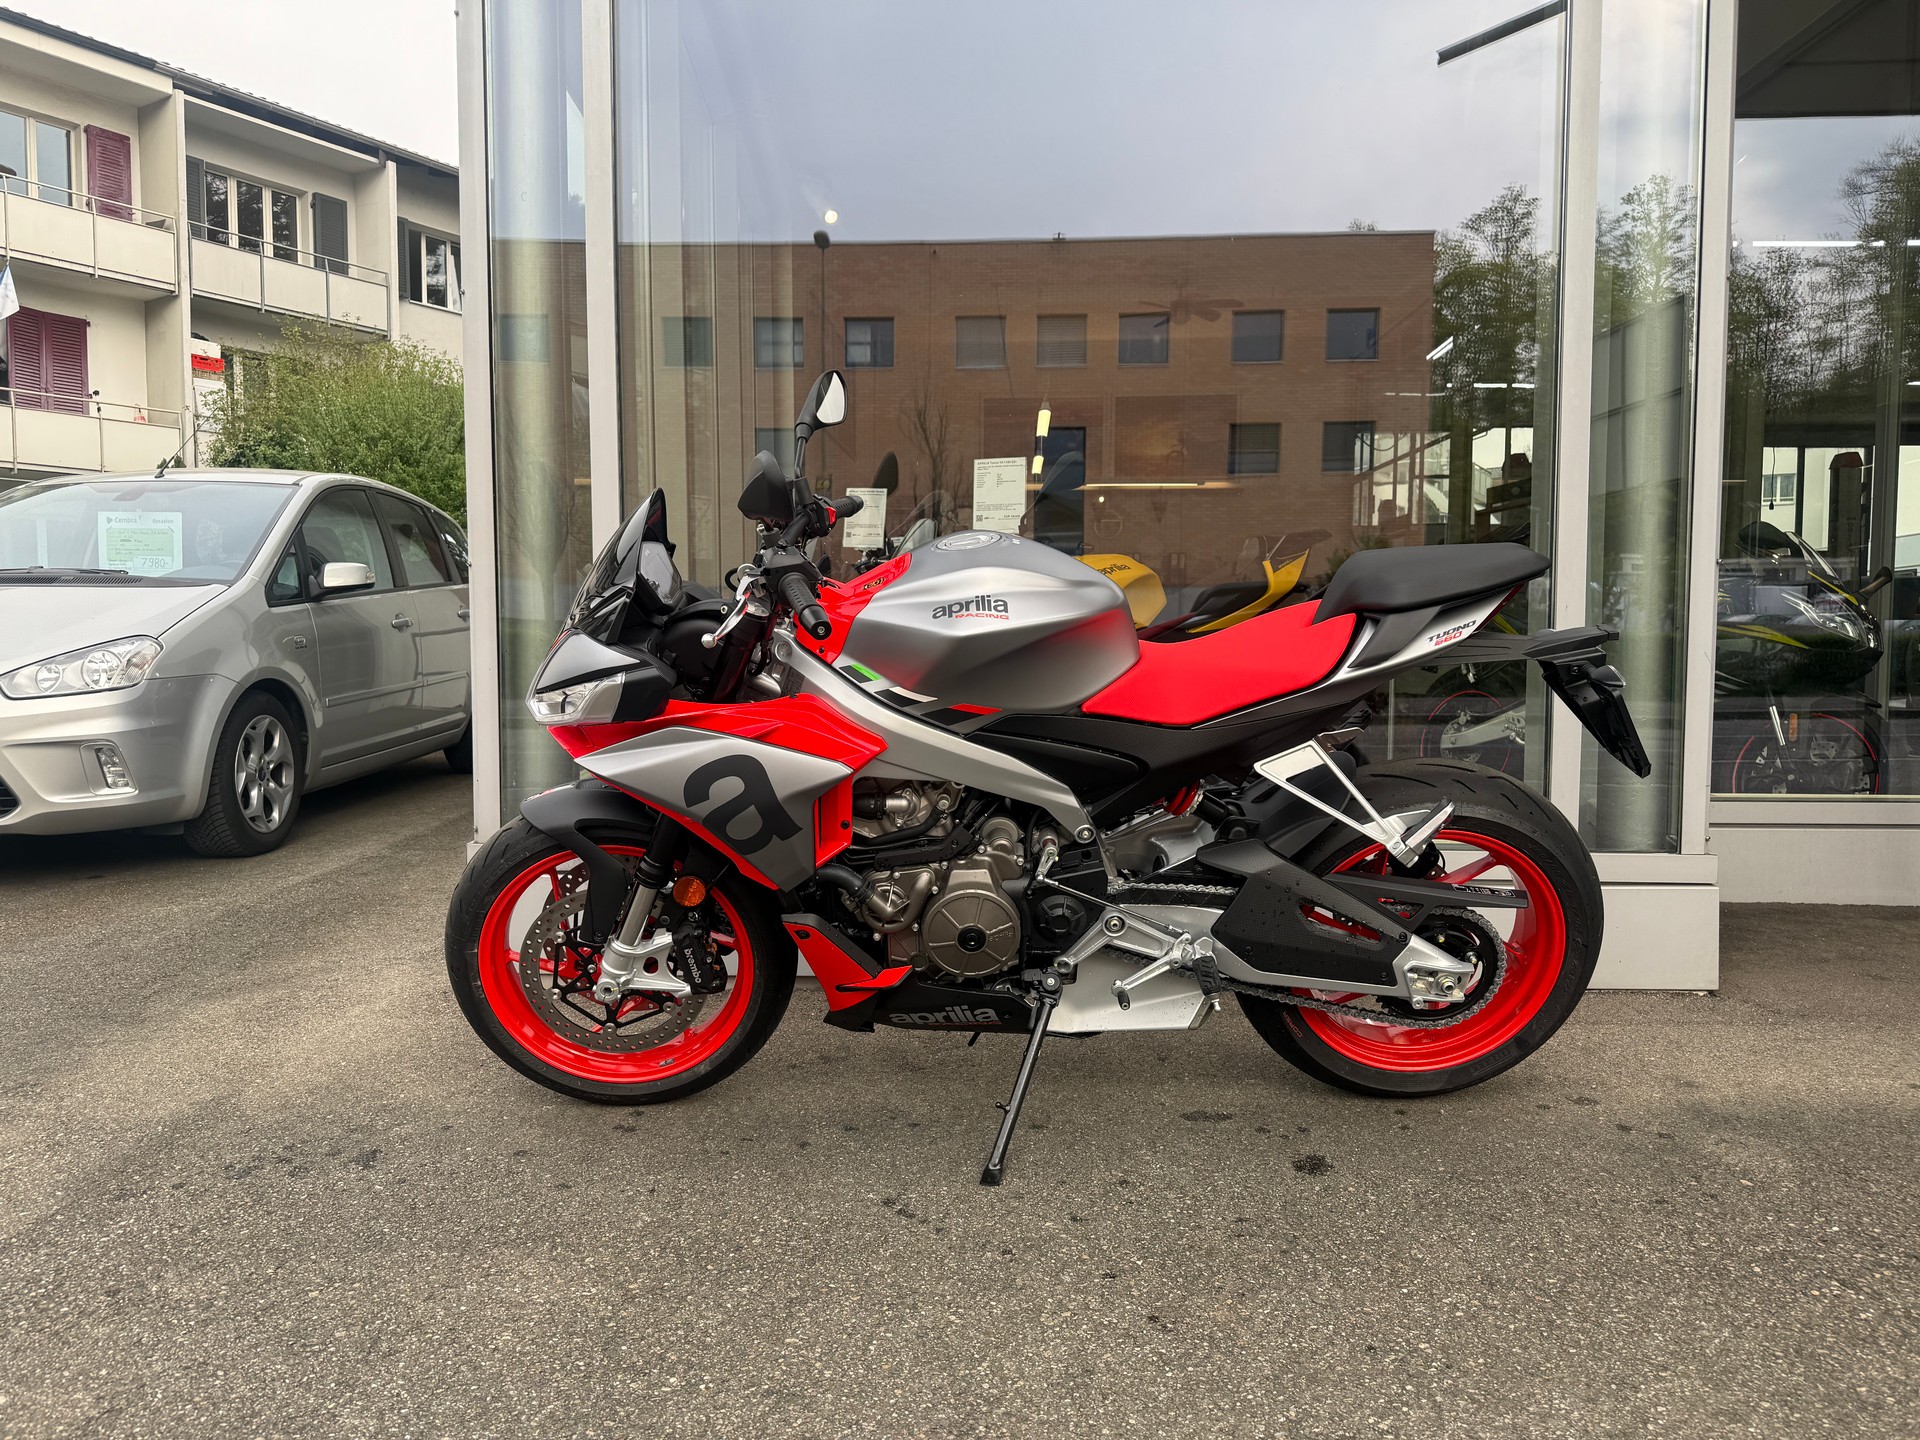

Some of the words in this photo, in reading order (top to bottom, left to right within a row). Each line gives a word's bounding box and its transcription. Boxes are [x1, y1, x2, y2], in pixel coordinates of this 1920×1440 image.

[931, 594, 1009, 620] aprilia
[954, 612, 1009, 620] RACING
[1428, 620, 1477, 642] TUONO
[1434, 631, 1463, 646] 660
[683, 754, 804, 856] a
[683, 947, 702, 984] brembo
[888, 1004, 1000, 1025] aprilia
